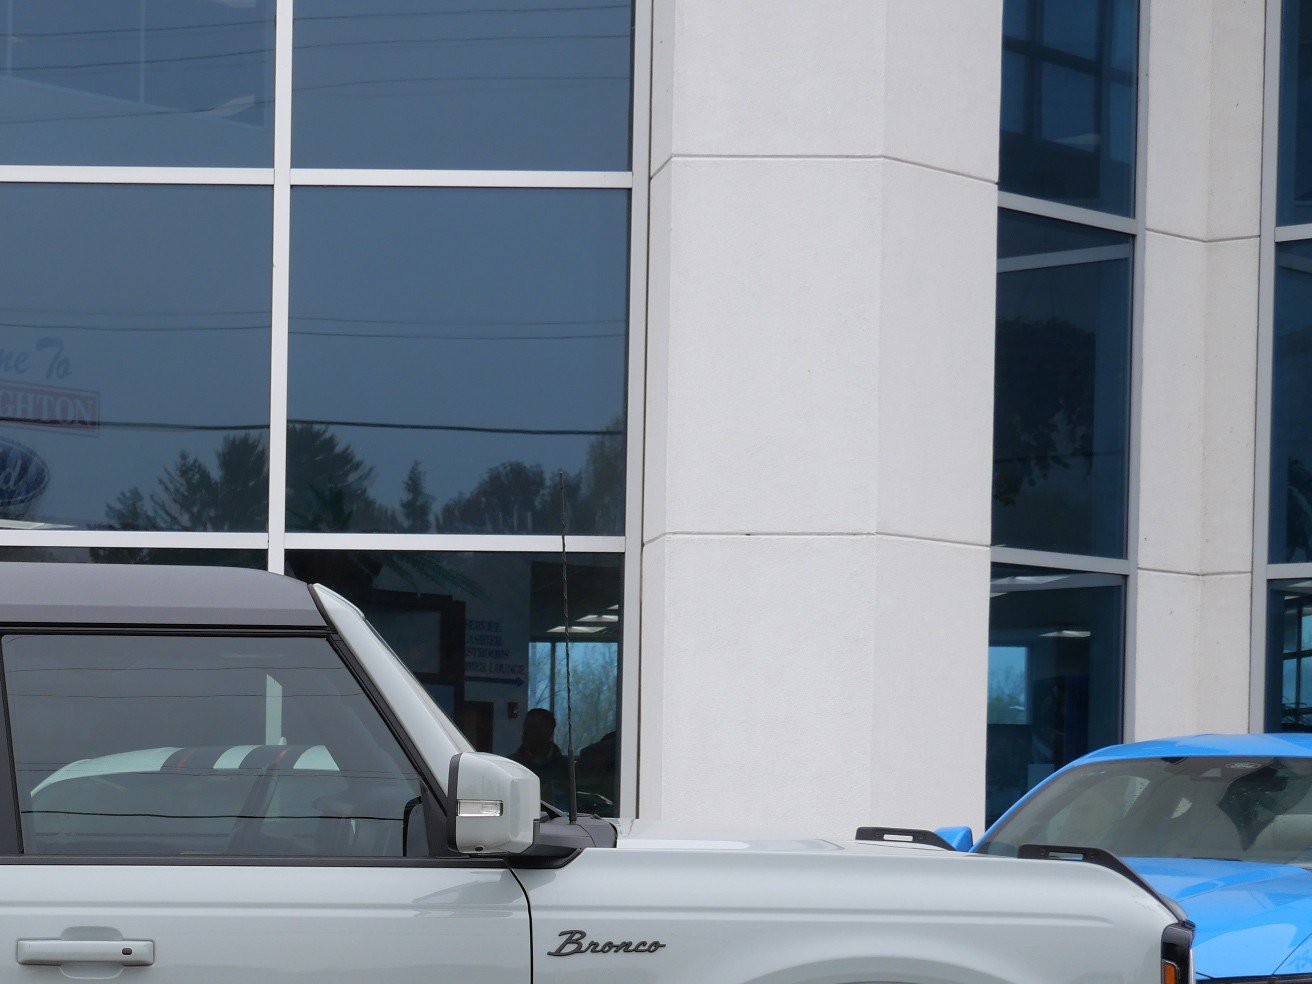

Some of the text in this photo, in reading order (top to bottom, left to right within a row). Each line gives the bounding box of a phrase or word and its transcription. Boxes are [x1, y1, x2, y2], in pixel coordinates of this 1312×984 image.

[35, 337, 73, 380] To
[467, 635, 502, 646] ASHIER
[547, 929, 667, 957] Bronco
